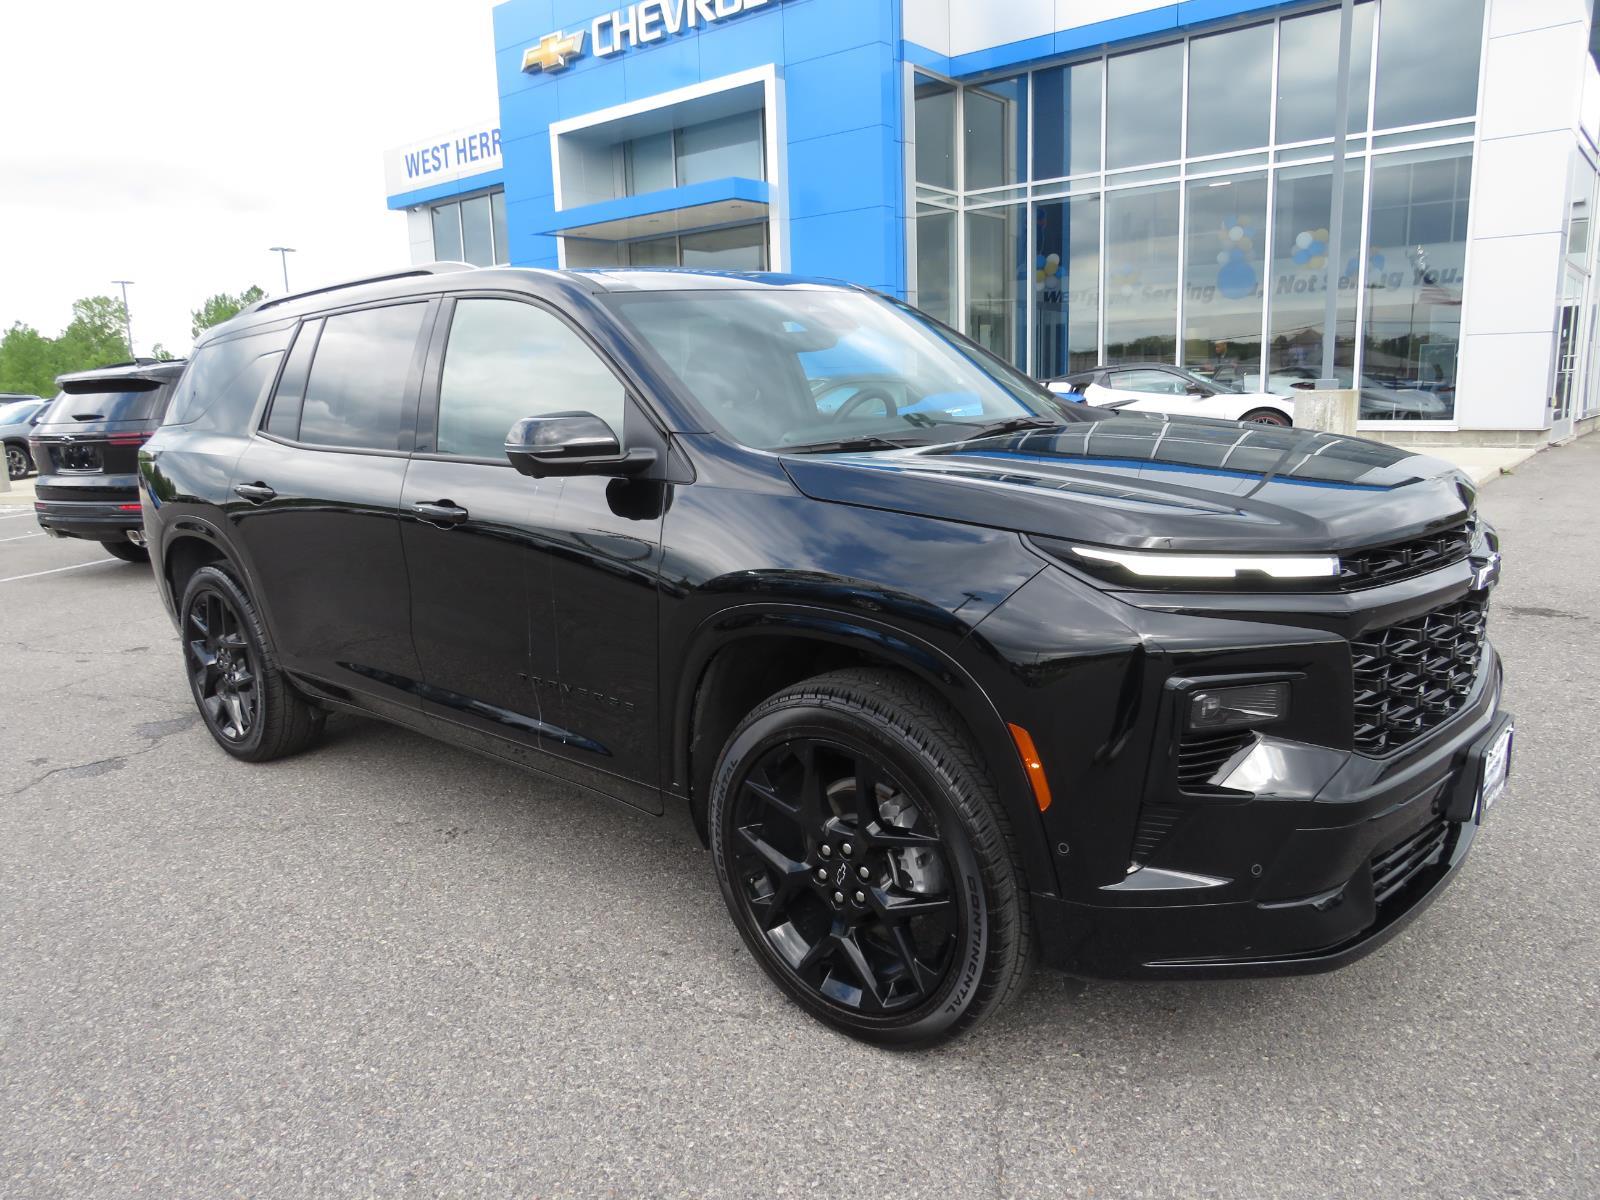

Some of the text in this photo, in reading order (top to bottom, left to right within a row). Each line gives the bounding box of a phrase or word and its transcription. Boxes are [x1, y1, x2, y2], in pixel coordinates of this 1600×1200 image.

[591, 0, 768, 57] CHEVR
[405, 128, 502, 179] WEST HERR
[1141, 280, 1216, 304] Sering
[1276, 273, 1320, 295] Not
[945, 875, 983, 1014] CONTINENTAL
